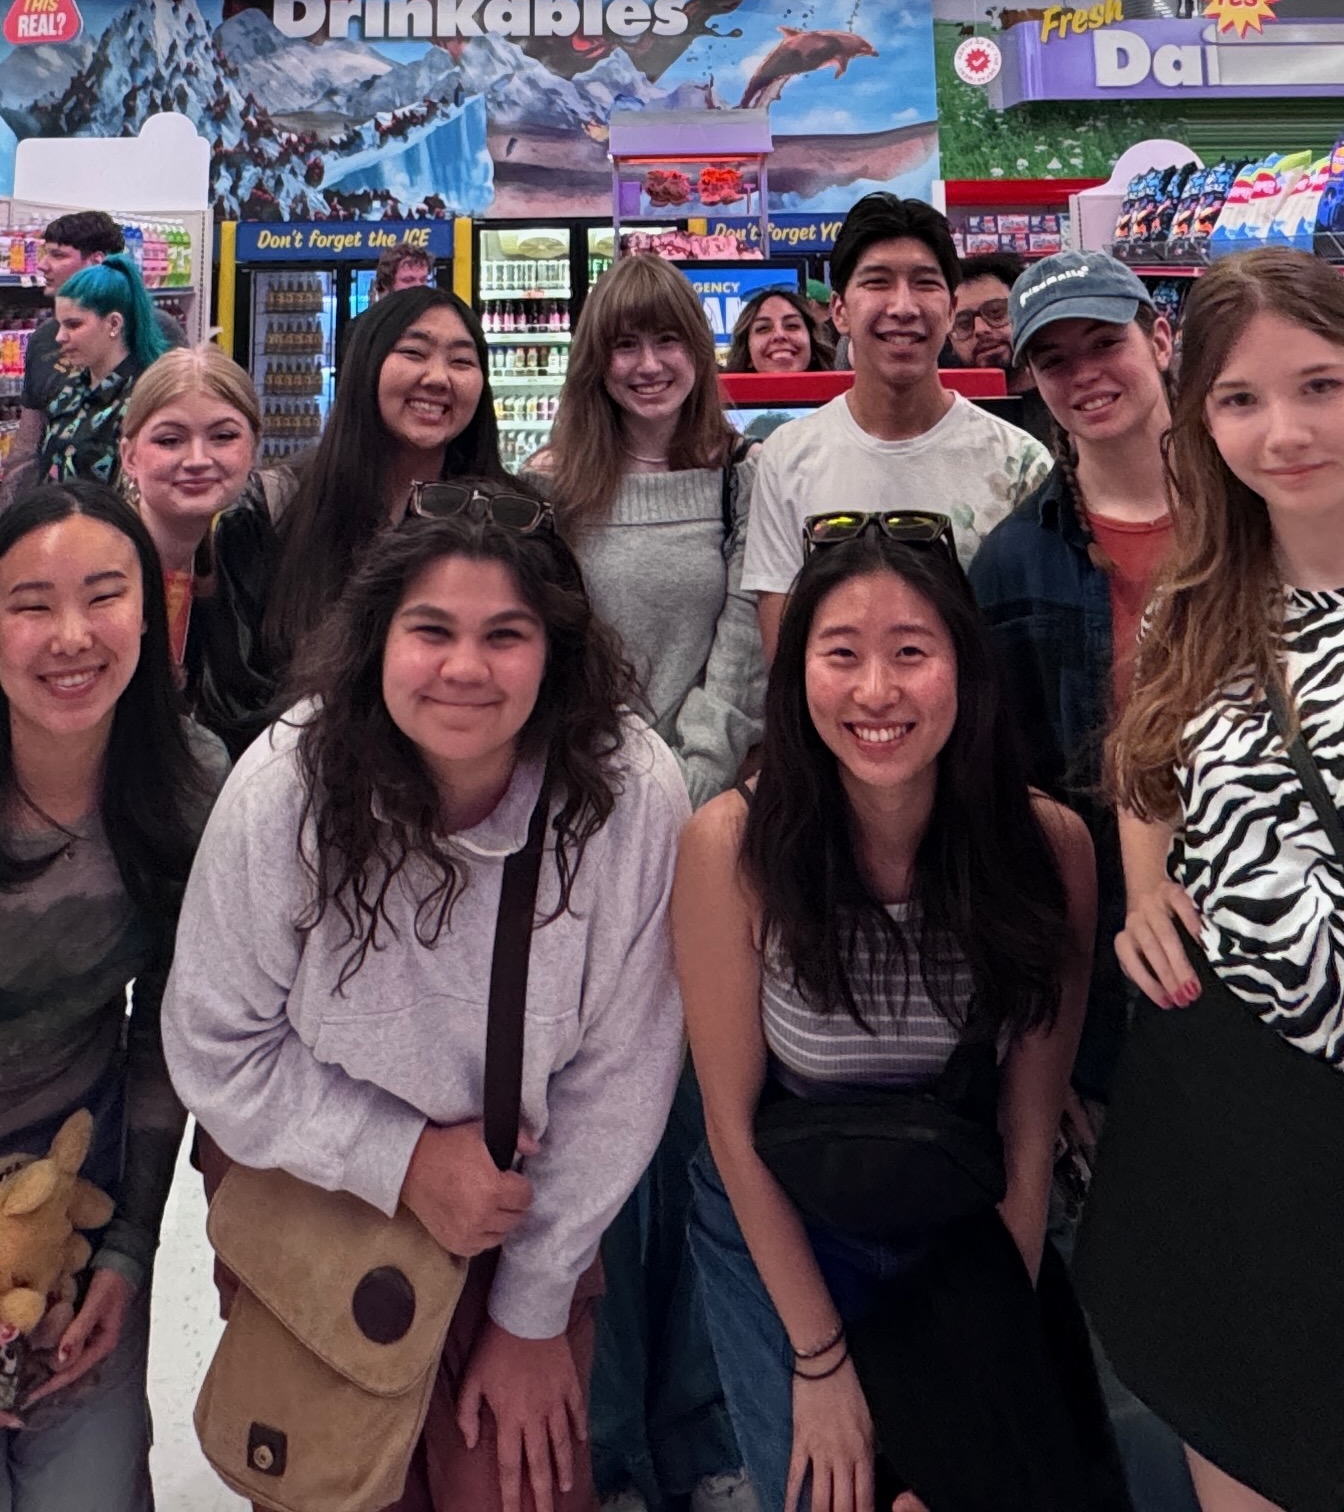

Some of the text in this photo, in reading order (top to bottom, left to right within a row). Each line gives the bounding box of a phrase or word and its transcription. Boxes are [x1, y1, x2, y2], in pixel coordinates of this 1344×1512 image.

[17, 13, 67, 37] REAL?
[257, 228, 430, 253] Don't forget the ICE
[766, 224, 817, 245] forget
